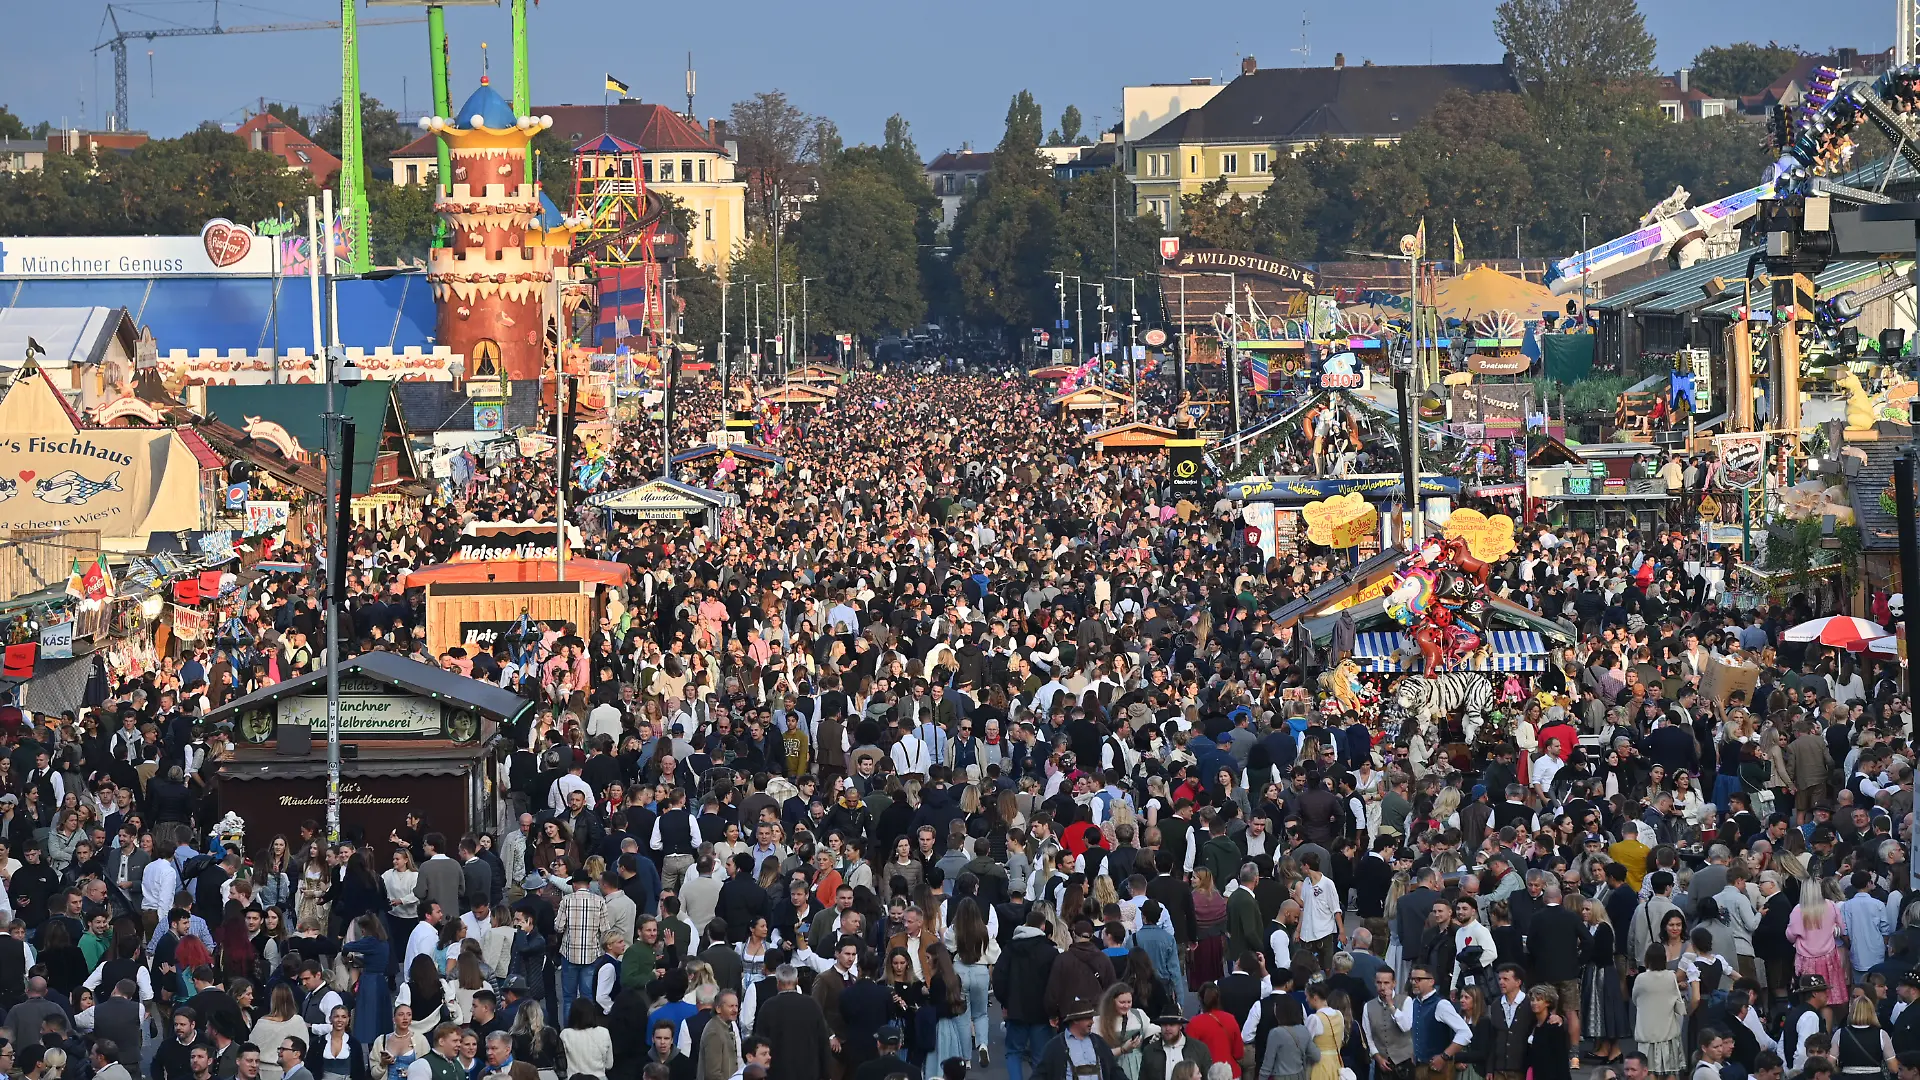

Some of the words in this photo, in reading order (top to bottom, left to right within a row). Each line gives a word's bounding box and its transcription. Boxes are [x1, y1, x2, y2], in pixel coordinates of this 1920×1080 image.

[22, 256, 110, 272] Münchner
[119, 256, 183, 272] Genuss
[1196, 252, 1301, 281] WILDSTUBEN
[1478, 360, 1519, 369] Bratwurst
[1321, 374, 1361, 388] SHOP
[29, 437, 133, 467] Fischhaus
[1240, 481, 1274, 499] Pins
[1, 521, 9, 529] a
[14, 518, 71, 531] scheene
[73, 505, 121, 525] Wies'n
[644, 511, 677, 519] Mandeln
[460, 543, 512, 560] Heisse
[42, 633, 71, 646] KÄSE
[338, 700, 391, 712] ünchner
[279, 794, 328, 806] Münchner
